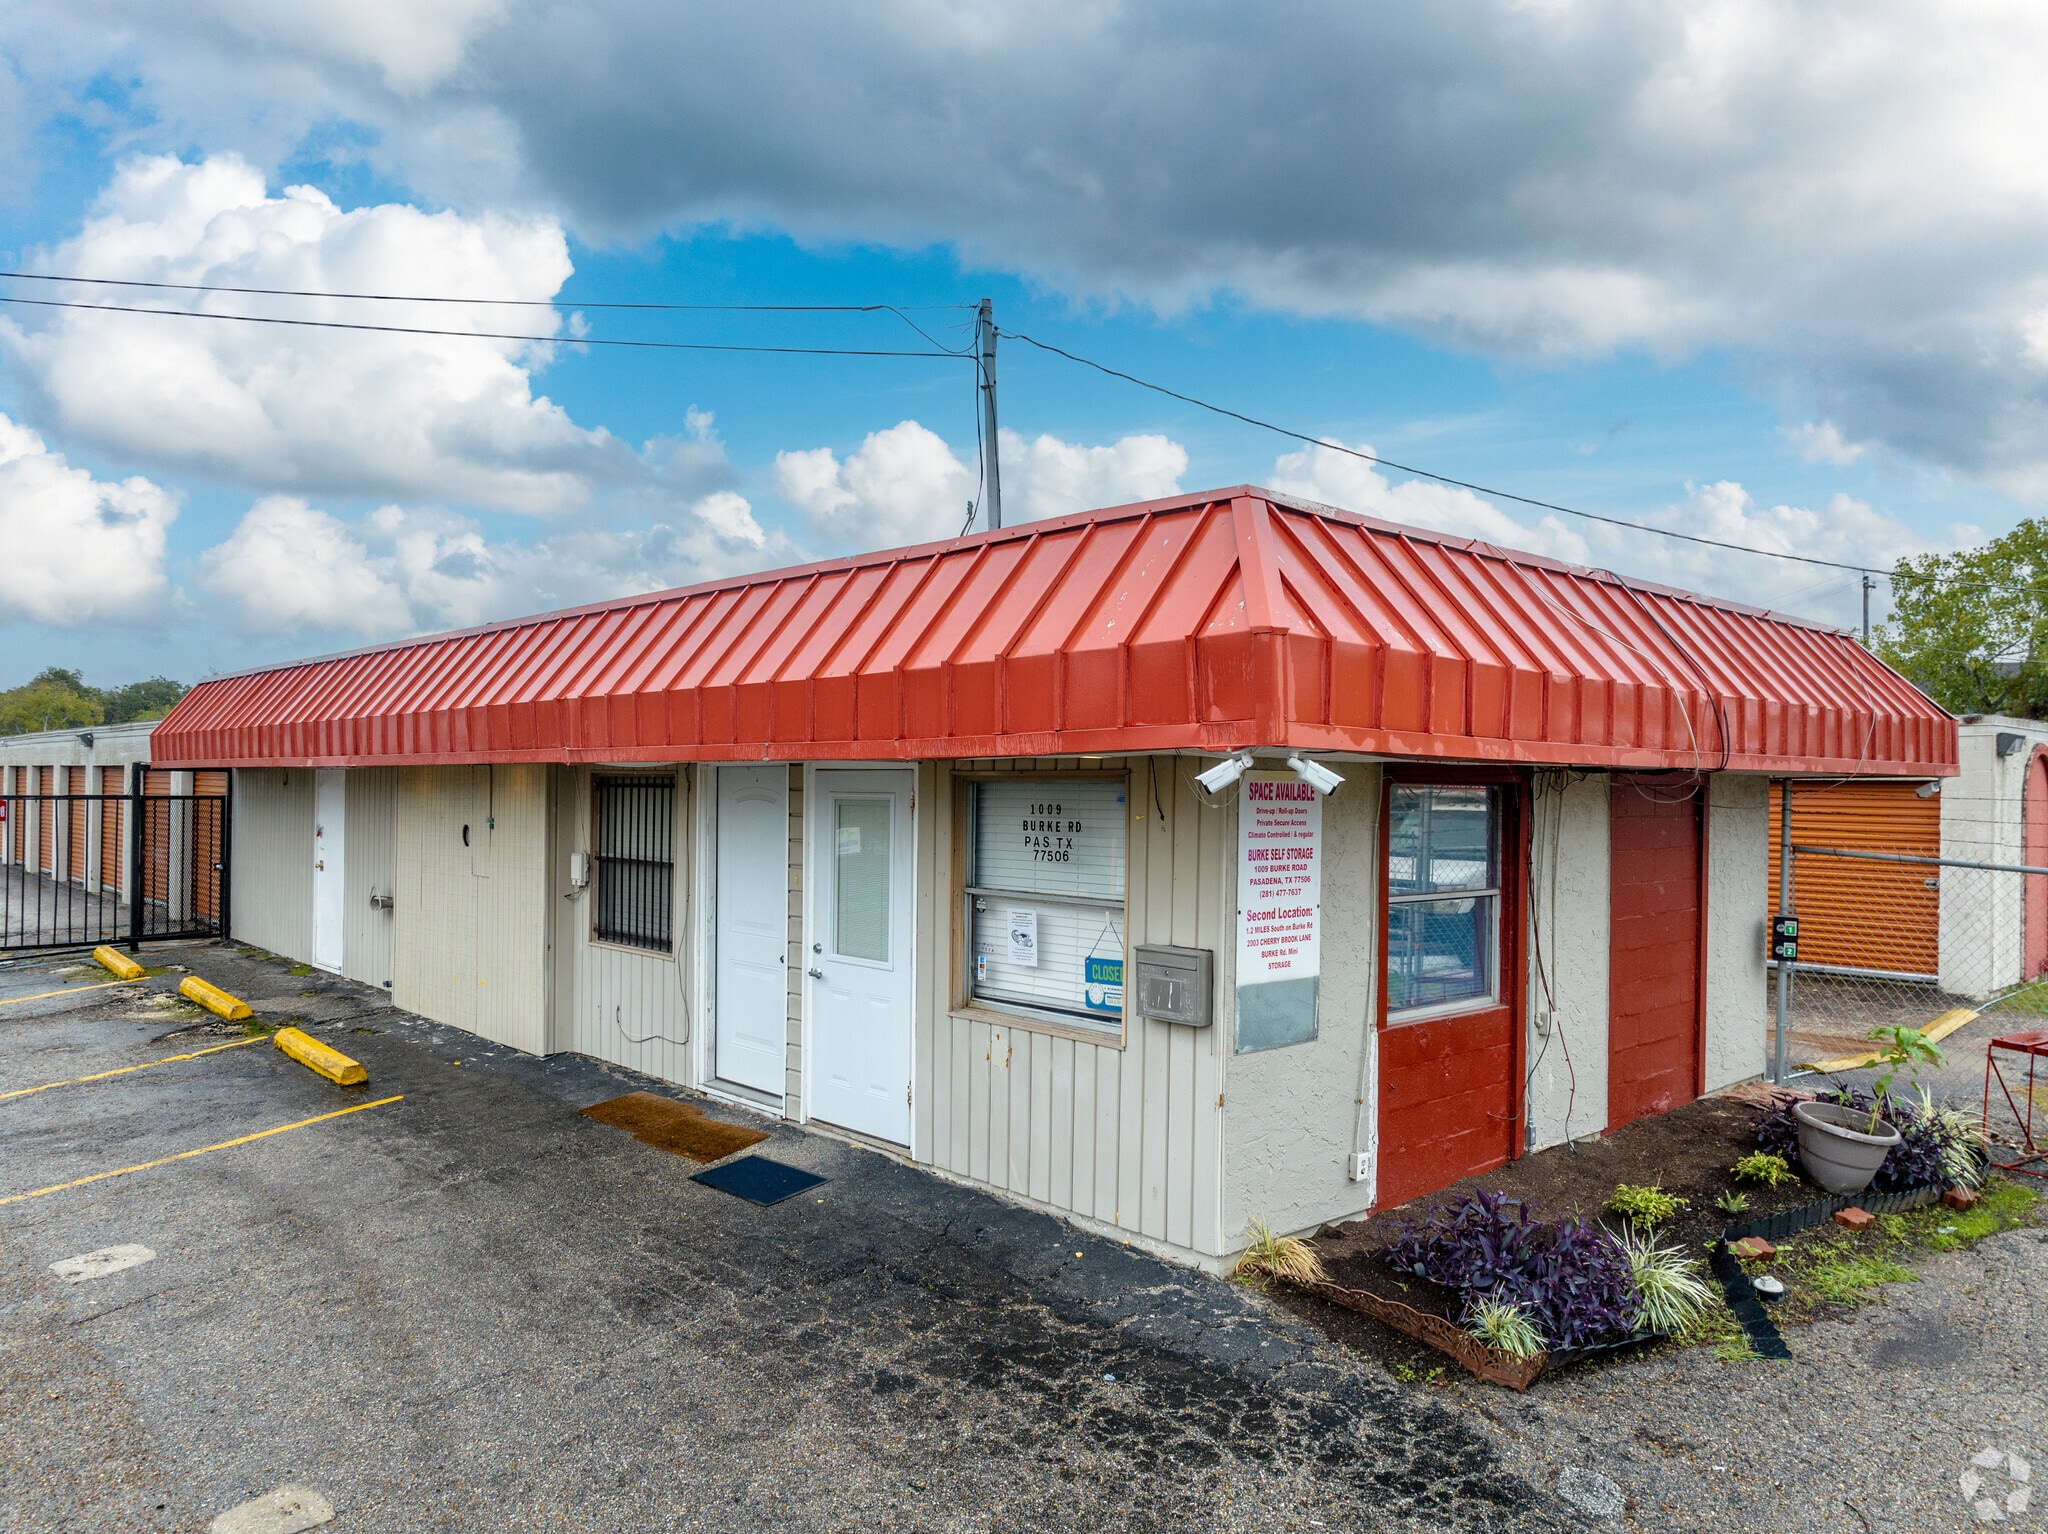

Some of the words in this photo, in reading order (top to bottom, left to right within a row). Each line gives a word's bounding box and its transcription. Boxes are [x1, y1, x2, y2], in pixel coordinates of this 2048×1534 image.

[1249, 782, 1274, 801] SPACE
[1275, 783, 1315, 802] AVAILABLE
[1031, 804, 1062, 815] 1009
[1256, 807, 1276, 816] Drive-up
[1279, 808, 1294, 816] Roll-up
[1023, 820, 1061, 833] BURKE
[1291, 819, 1307, 827] Access
[1267, 831, 1291, 839] Controlled
[1298, 831, 1314, 839] regular
[1034, 850, 1070, 862] 77506
[1248, 849, 1270, 861] BURKE
[1270, 848, 1286, 861] SELF
[1286, 847, 1314, 860] STORAGE
[1270, 865, 1290, 873] BURKE
[1292, 864, 1308, 872] ROAD
[1250, 878, 1284, 886] PASADENA,
[1285, 877, 1293, 885] TX
[1294, 876, 1312, 884] 77506
[1260, 890, 1275, 900] (281)
[1276, 889, 1302, 897] 477-7637
[1247, 908, 1276, 922] Second
[1278, 906, 1313, 920] Location:
[1255, 925, 1270, 934] MILES
[1271, 924, 1285, 933] South
[1293, 923, 1306, 931] Burke
[1247, 939, 1260, 948] 2003
[1260, 937, 1281, 946] CHERRY
[1281, 936, 1299, 944] BROOK
[1300, 934, 1312, 942] LANE
[1262, 950, 1279, 959] BURKE
[1289, 947, 1299, 955] Mini
[1268, 961, 1292, 970] STORAGE
